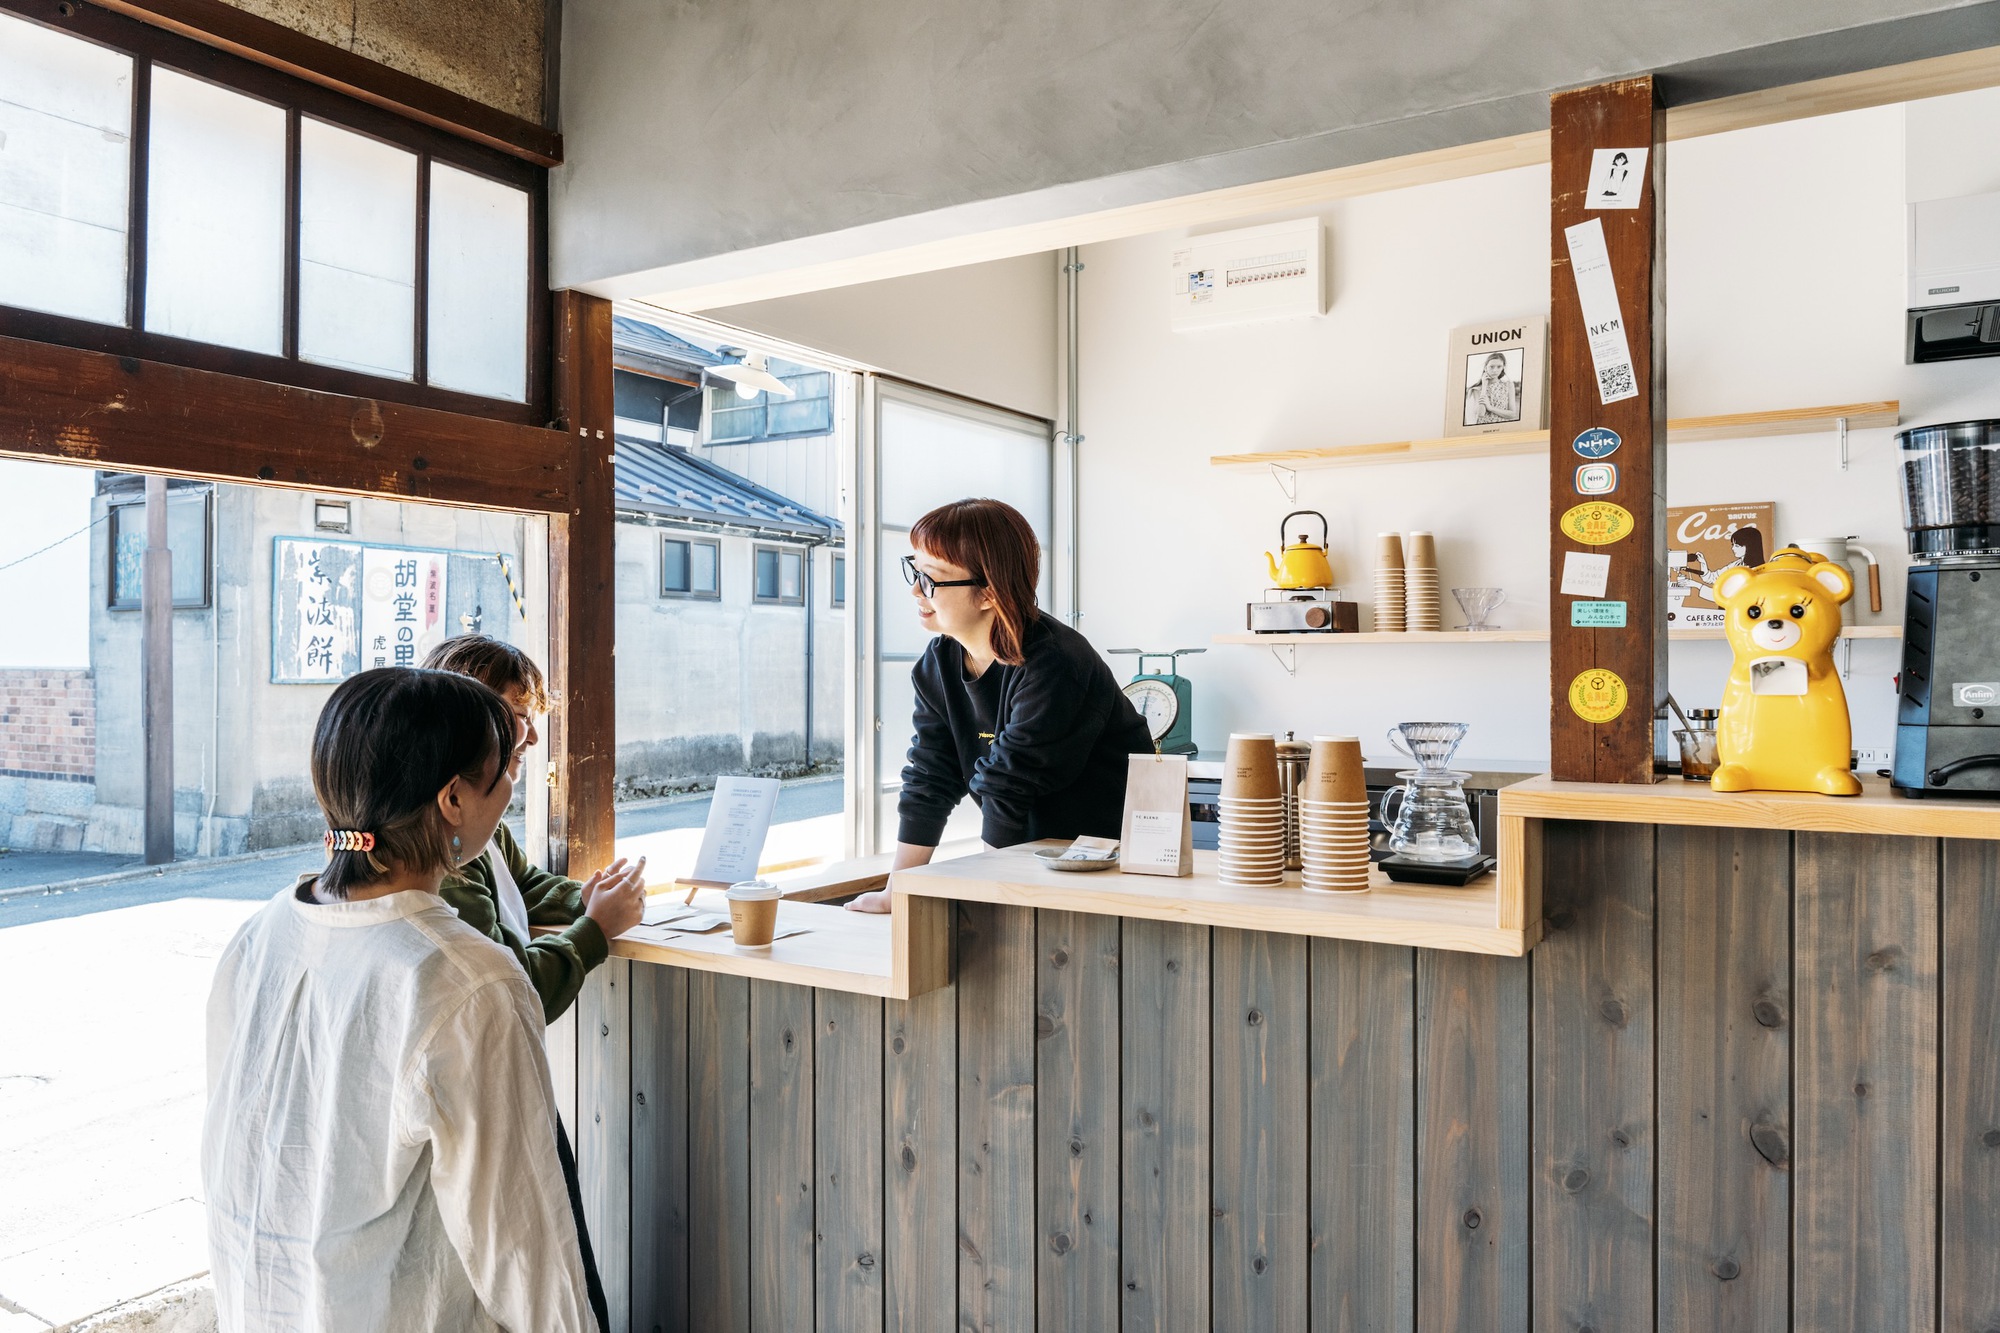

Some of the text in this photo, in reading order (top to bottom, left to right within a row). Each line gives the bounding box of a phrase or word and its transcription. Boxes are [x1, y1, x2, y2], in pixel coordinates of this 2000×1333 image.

[1590, 319, 1619, 336] NKM
[1471, 328, 1522, 345] UNION
[1578, 437, 1615, 449] NHK
[1727, 512, 1757, 520] BRUTUS
[1676, 511, 1758, 544] Cas
[1580, 571, 1603, 579] SAWA
[1565, 578, 1602, 586] CAMPUS
[393, 558, 418, 668] 胡堂の里
[1686, 614, 1705, 622] CAFE
[1706, 614, 1712, 622] &
[1965, 689, 1993, 699] Anfim
